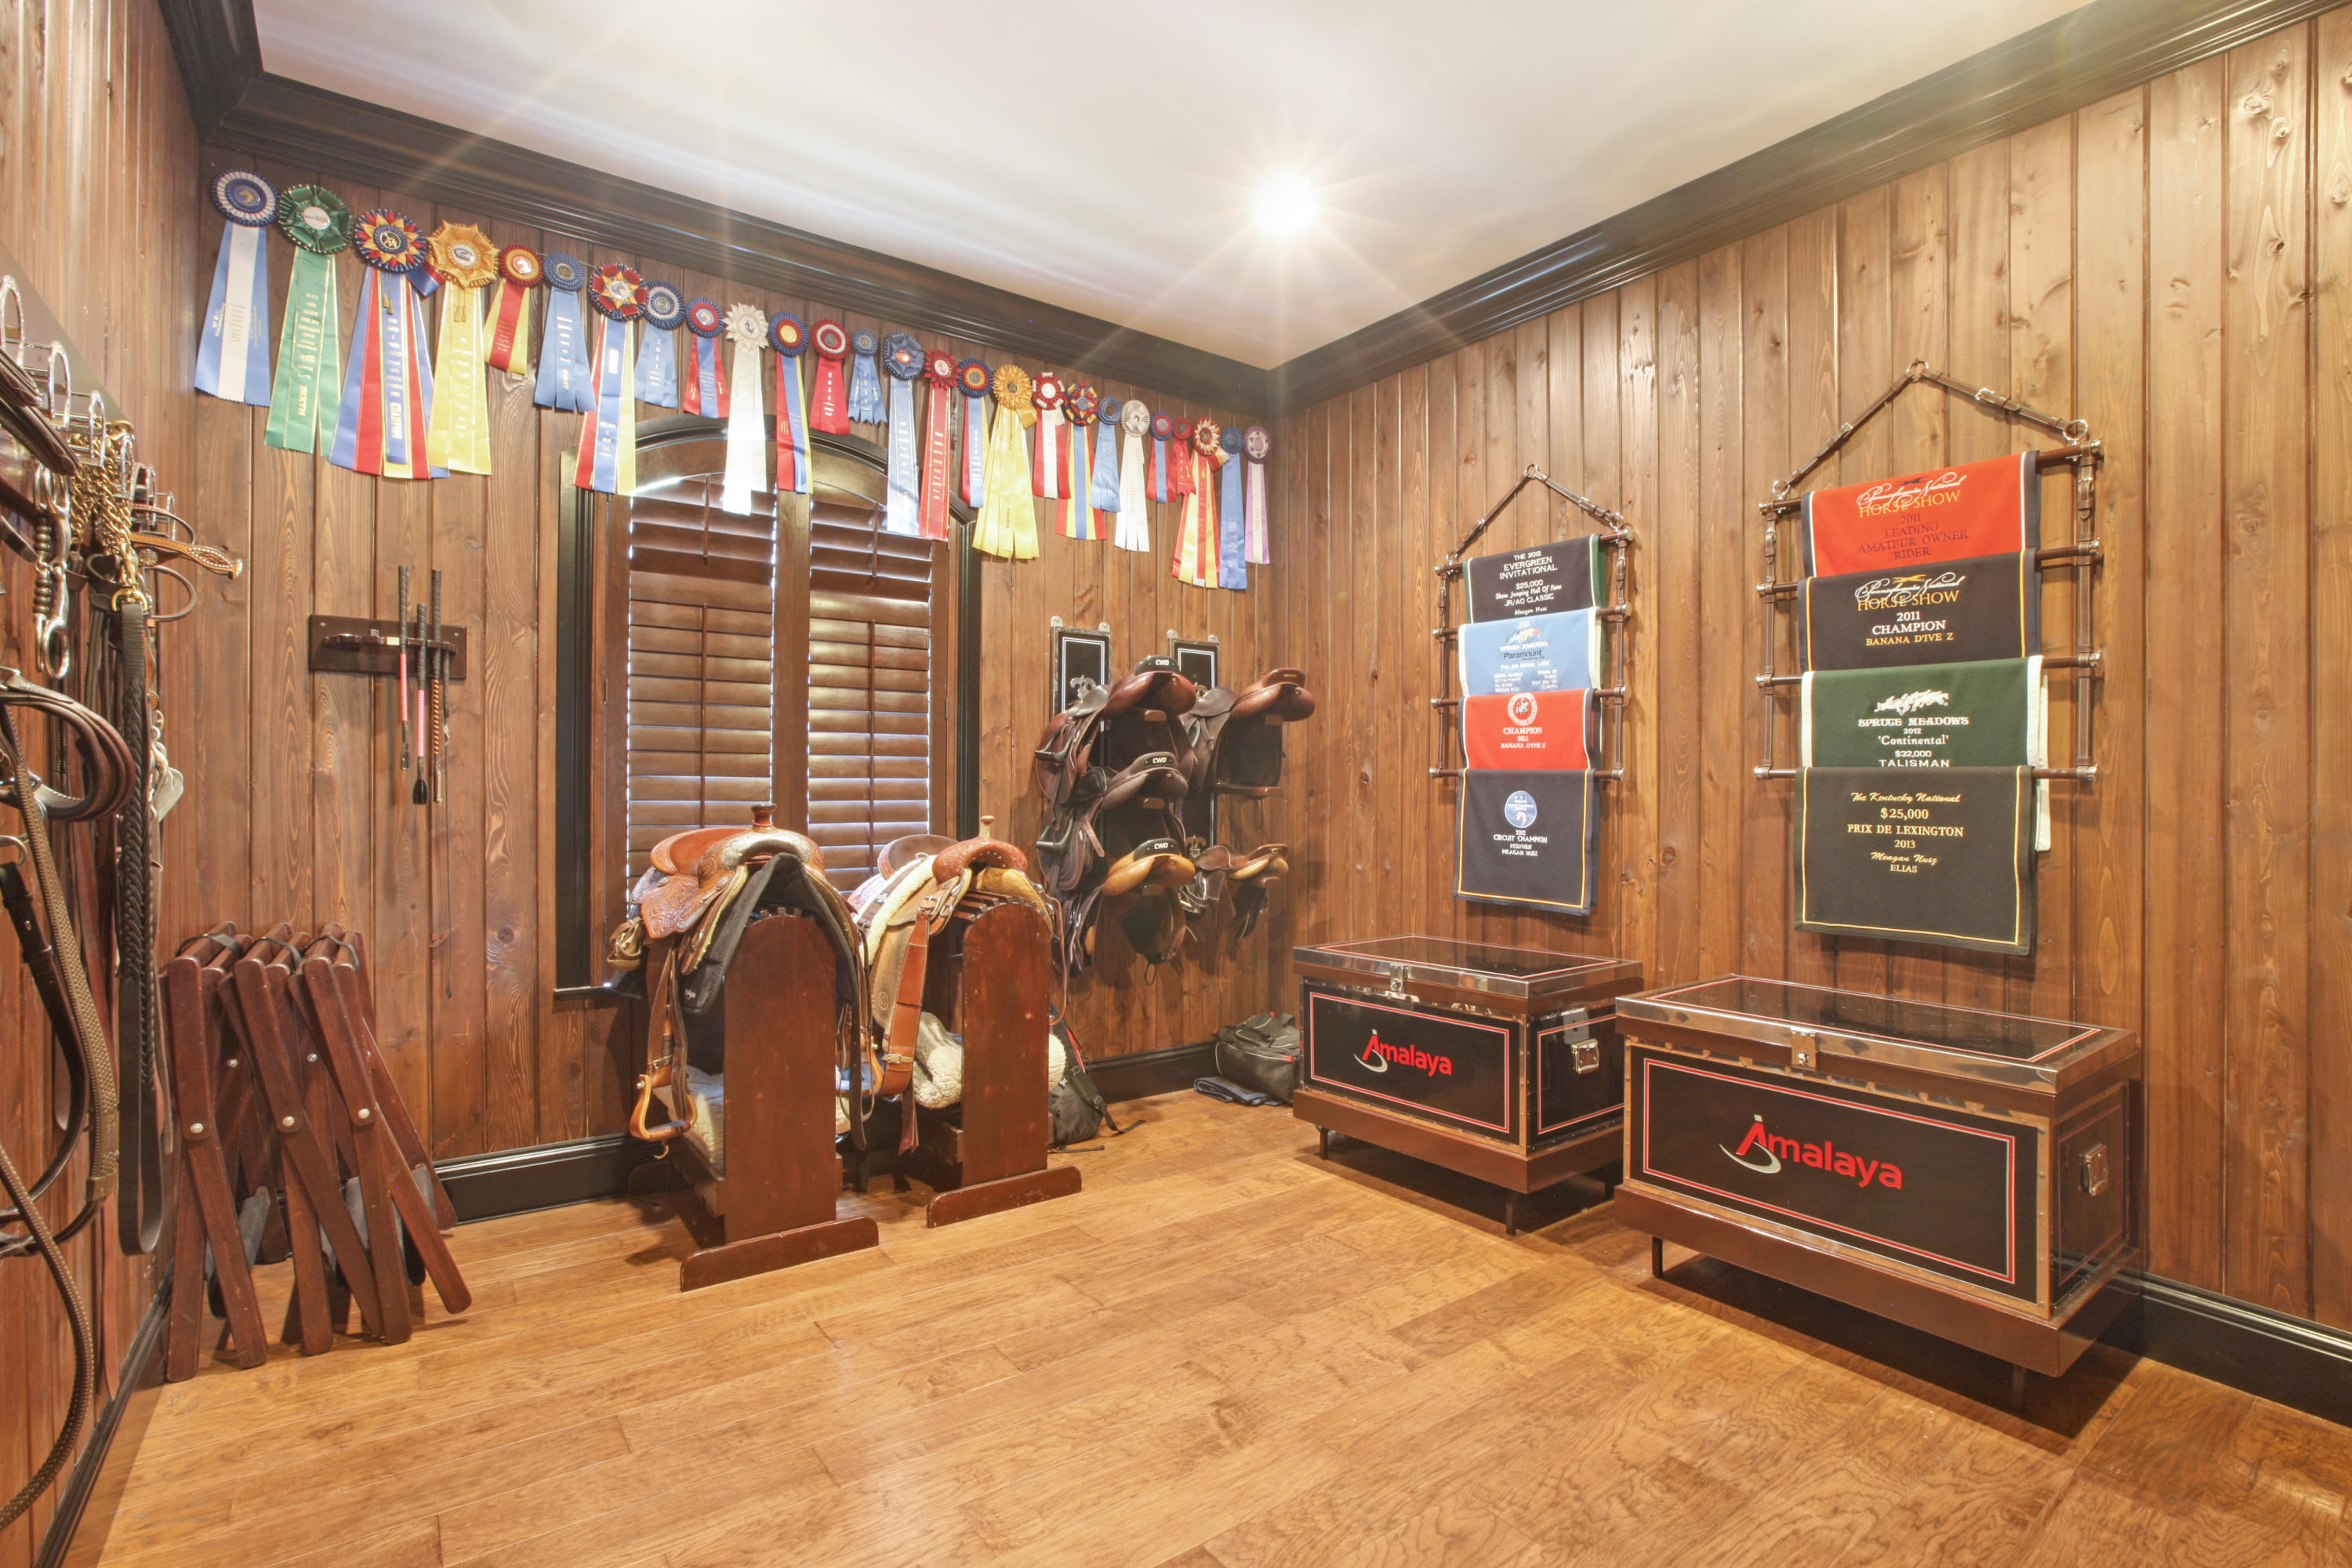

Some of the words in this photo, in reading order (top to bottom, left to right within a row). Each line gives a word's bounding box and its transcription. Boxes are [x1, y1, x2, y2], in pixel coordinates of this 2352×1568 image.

[1859, 499, 1908, 518] HORSE
[1913, 489, 1962, 509] SHOW
[1901, 514, 1921, 524] 2011
[1884, 522, 1939, 539] LEADING
[1857, 538, 1916, 554] AMATEUR
[1922, 530, 1969, 545] OWNER
[1894, 547, 1931, 561] RIDER
[1504, 556, 1552, 572] EVERGREEN
[1499, 564, 1559, 580] INVITATIONAL
[1515, 579, 1544, 590] $25,000
[1504, 598, 1526, 607] JR/AO
[1526, 593, 1555, 604] CLASSIC
[1857, 596, 1907, 612] HORSE
[1911, 590, 1960, 606] SHOW
[1896, 611, 1921, 622] 2011
[1872, 619, 1947, 635] CHAMPION
[1866, 636, 1910, 646] BANANA
[1946, 632, 1955, 641] Z
[1504, 649, 1542, 659] Paramount
[1858, 717, 1903, 728] SPRUCE
[1908, 716, 1970, 726] MEADOWS
[1894, 750, 1933, 758] $32,000
[1878, 759, 1950, 768] TALISMAN
[1850, 792, 1867, 802] The
[1869, 792, 1914, 804] Kentucky
[1915, 792, 1962, 803] National
[1880, 808, 1929, 821] $25,000
[1847, 823, 1873, 833] PRIX
[1876, 825, 1892, 834] DE
[1896, 826, 1964, 837] LEXINGTON
[1894, 839, 1916, 848] 2013
[1871, 851, 1910, 863] Meagan
[1913, 854, 1938, 866] Nusz
[1890, 864, 1918, 873] ELIAS
[1360, 1029, 1453, 1077] Amalaya
[1733, 1114, 1903, 1190] Amalaya
